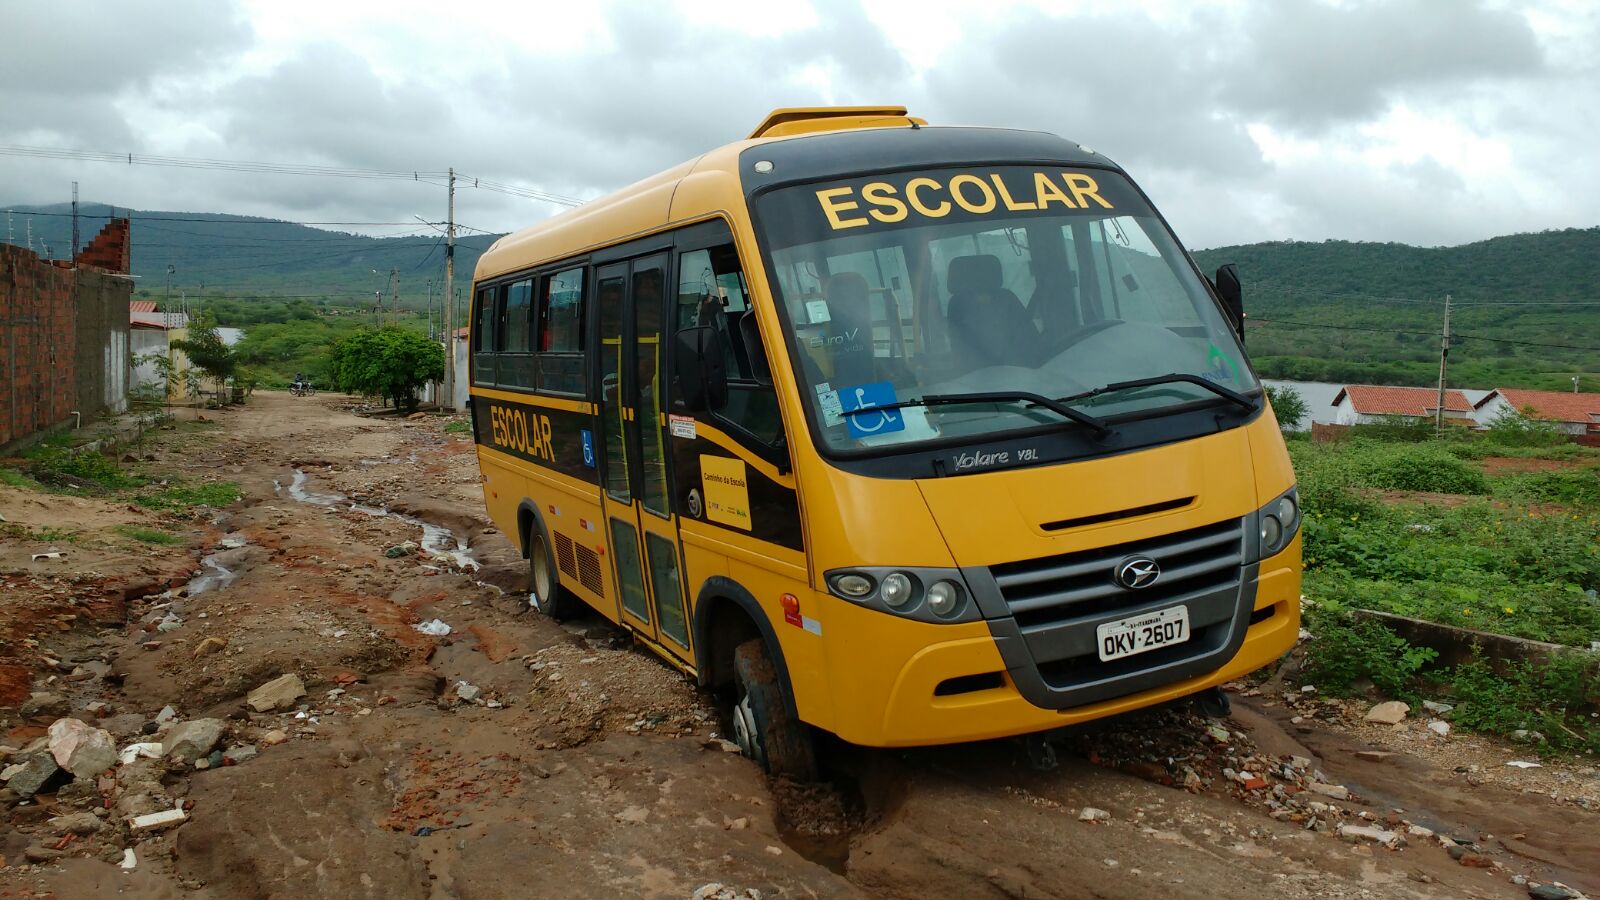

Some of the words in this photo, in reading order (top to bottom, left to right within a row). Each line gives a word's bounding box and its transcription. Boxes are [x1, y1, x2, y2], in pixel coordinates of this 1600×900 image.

[815, 172, 1114, 230] ESCOLAR
[490, 405, 556, 463] ESCOLAR
[703, 472, 723, 484] Caminho
[723, 475, 730, 485] da
[730, 477, 746, 488] Escola
[952, 450, 1009, 472] Volare
[1017, 448, 1039, 462] V8L
